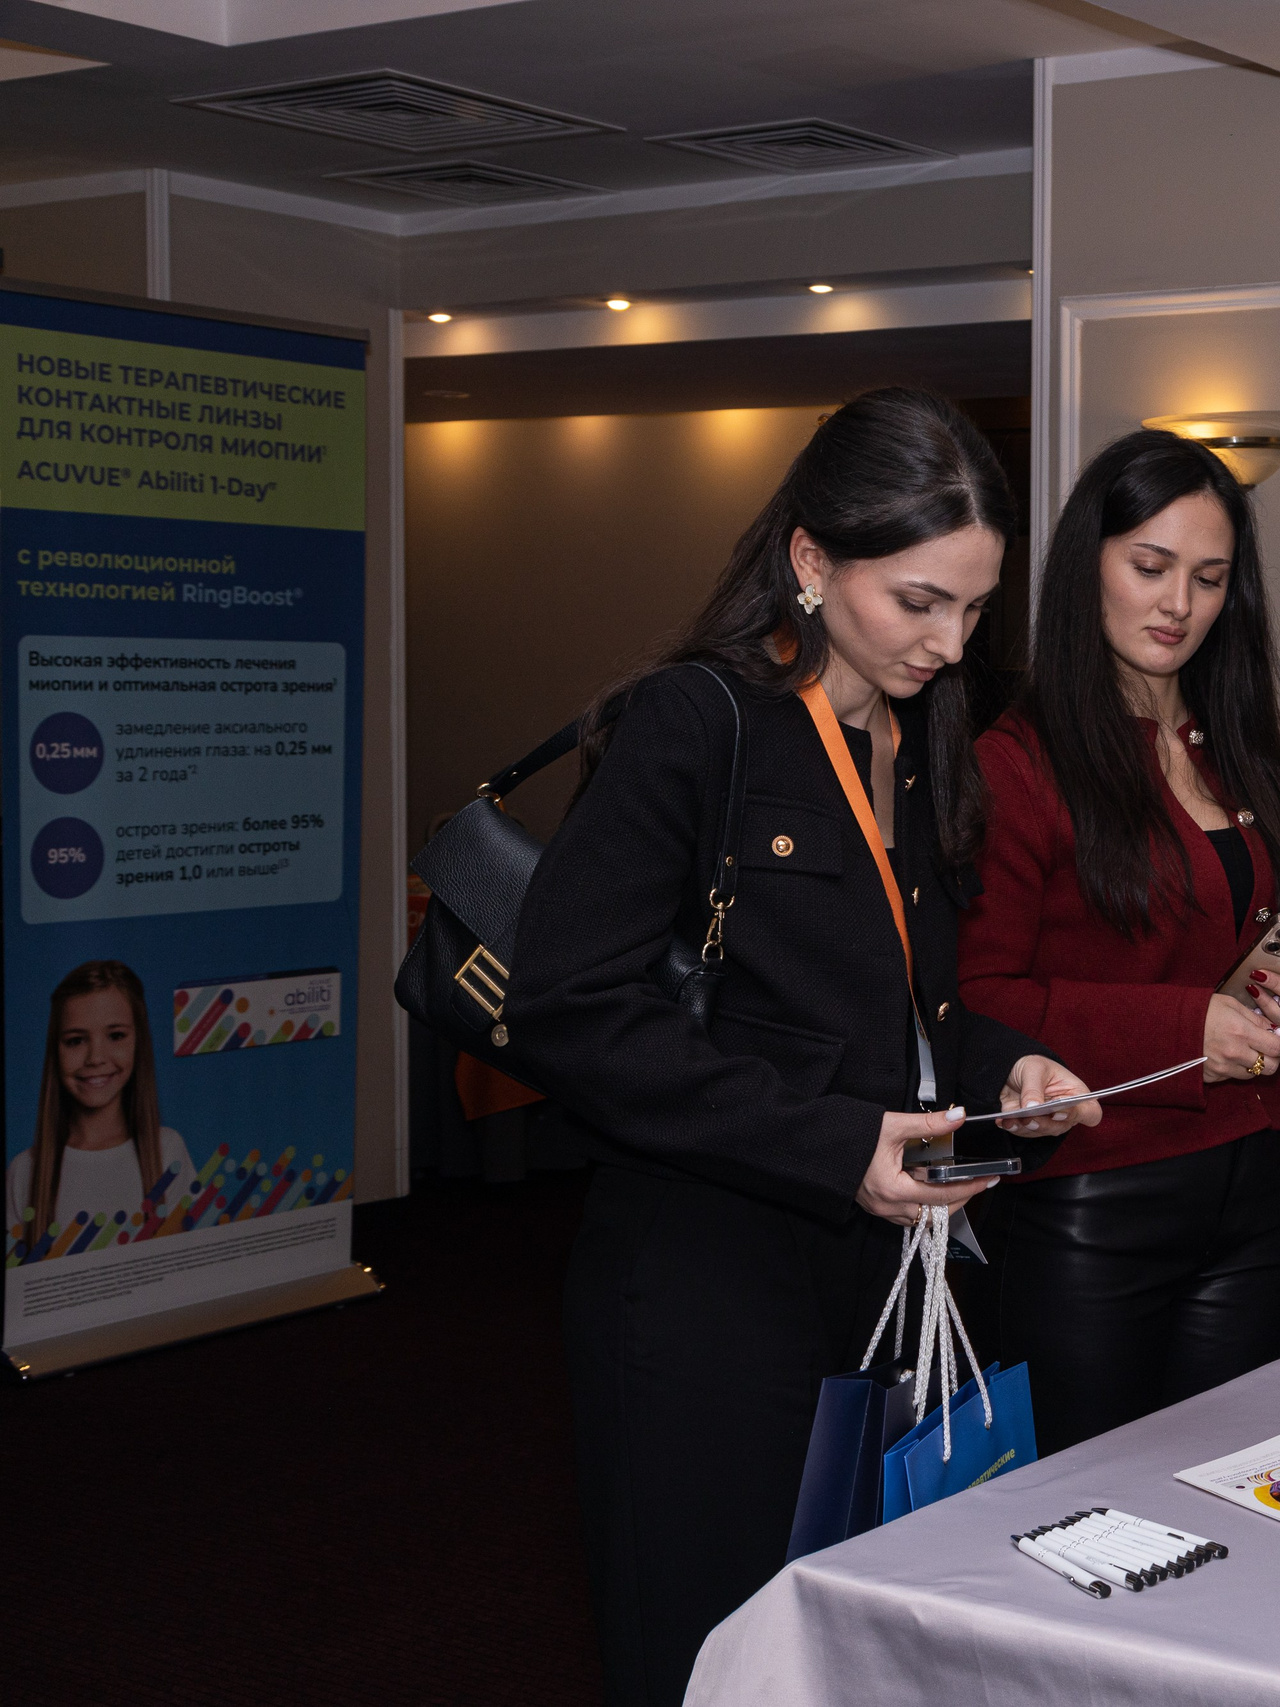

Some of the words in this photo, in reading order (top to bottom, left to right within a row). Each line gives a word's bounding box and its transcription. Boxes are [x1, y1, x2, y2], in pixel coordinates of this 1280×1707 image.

[17, 353, 112, 384] НОВЫЕ
[118, 365, 347, 410] ТЕРАПЕВТИЧЕСКИЕ
[17, 385, 191, 423] КОНТАКТНЫЕ
[198, 405, 284, 432] ЛИНЗЫ
[17, 417, 73, 441] ДЛЯ
[80, 422, 213, 454] КОНТРОЛЯ
[138, 471, 205, 494] Abiliti
[17, 550, 31, 566] с
[38, 548, 235, 575] революционной
[17, 578, 176, 603] технологией
[29, 650, 103, 668] Высокая
[107, 653, 232, 672] эффективность
[234, 657, 297, 671] лечения
[29, 678, 95, 692] миопии
[99, 680, 109, 692] и
[113, 679, 216, 694] оптимальная
[220, 680, 279, 695] острота
[116, 722, 211, 738] замедление
[214, 721, 308, 735] аксиального
[35, 743, 72, 763] 0,25
[73, 746, 98, 759] мм
[116, 744, 202, 762] удлинения
[254, 744, 271, 757] на
[275, 741, 307, 758] 0,25
[311, 743, 333, 756] мм
[116, 770, 134, 784] за
[138, 767, 149, 782] 2
[116, 823, 177, 840] острота
[242, 814, 287, 832] более
[291, 813, 325, 830] 95%
[48, 847, 87, 864] 95%
[116, 845, 162, 863] детей
[165, 842, 235, 860] достигли
[238, 839, 301, 858] остроты
[116, 868, 174, 888] зрения
[179, 865, 202, 882] 1,0
[206, 864, 235, 880] или
